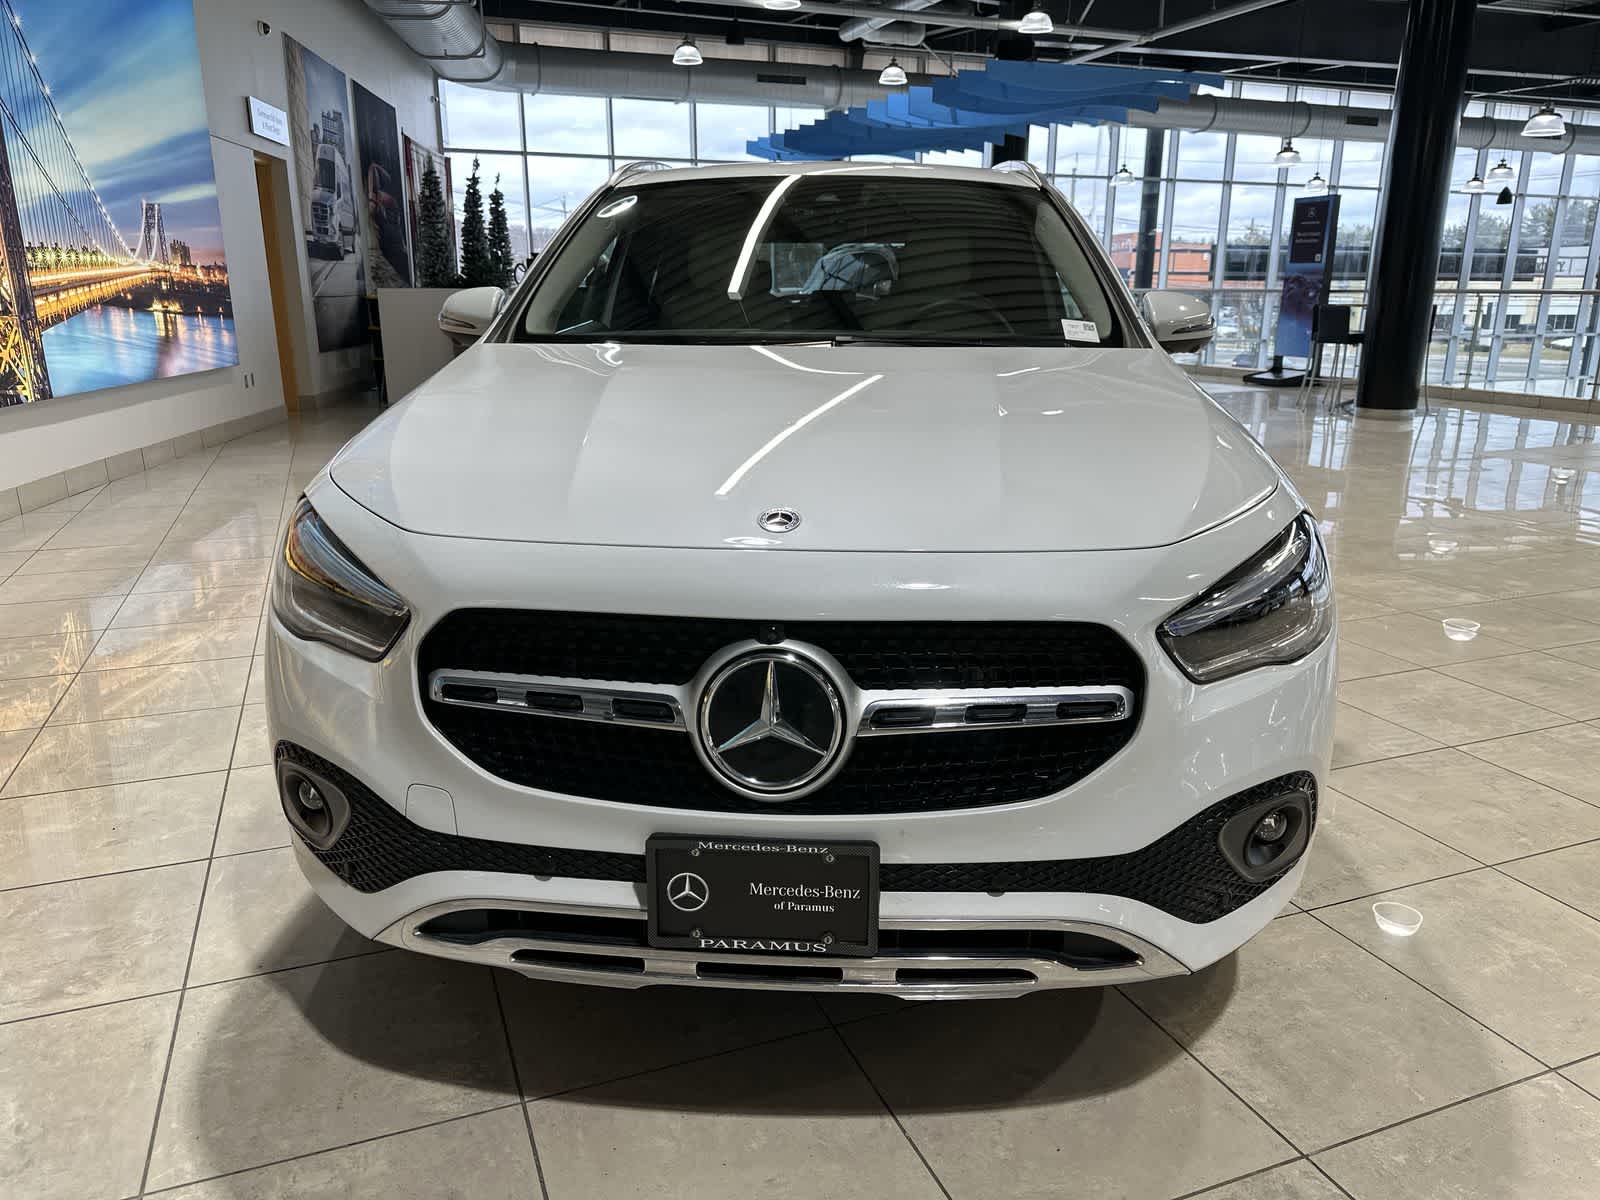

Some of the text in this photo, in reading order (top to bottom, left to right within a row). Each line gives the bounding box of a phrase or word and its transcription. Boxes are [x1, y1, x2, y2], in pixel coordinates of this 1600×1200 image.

[698, 841, 828, 853] Mercedes-Benz
[749, 882, 861, 899] Mercedes-Benz
[774, 901, 835, 912] of Paramus
[699, 939, 827, 952] PARAMUS
